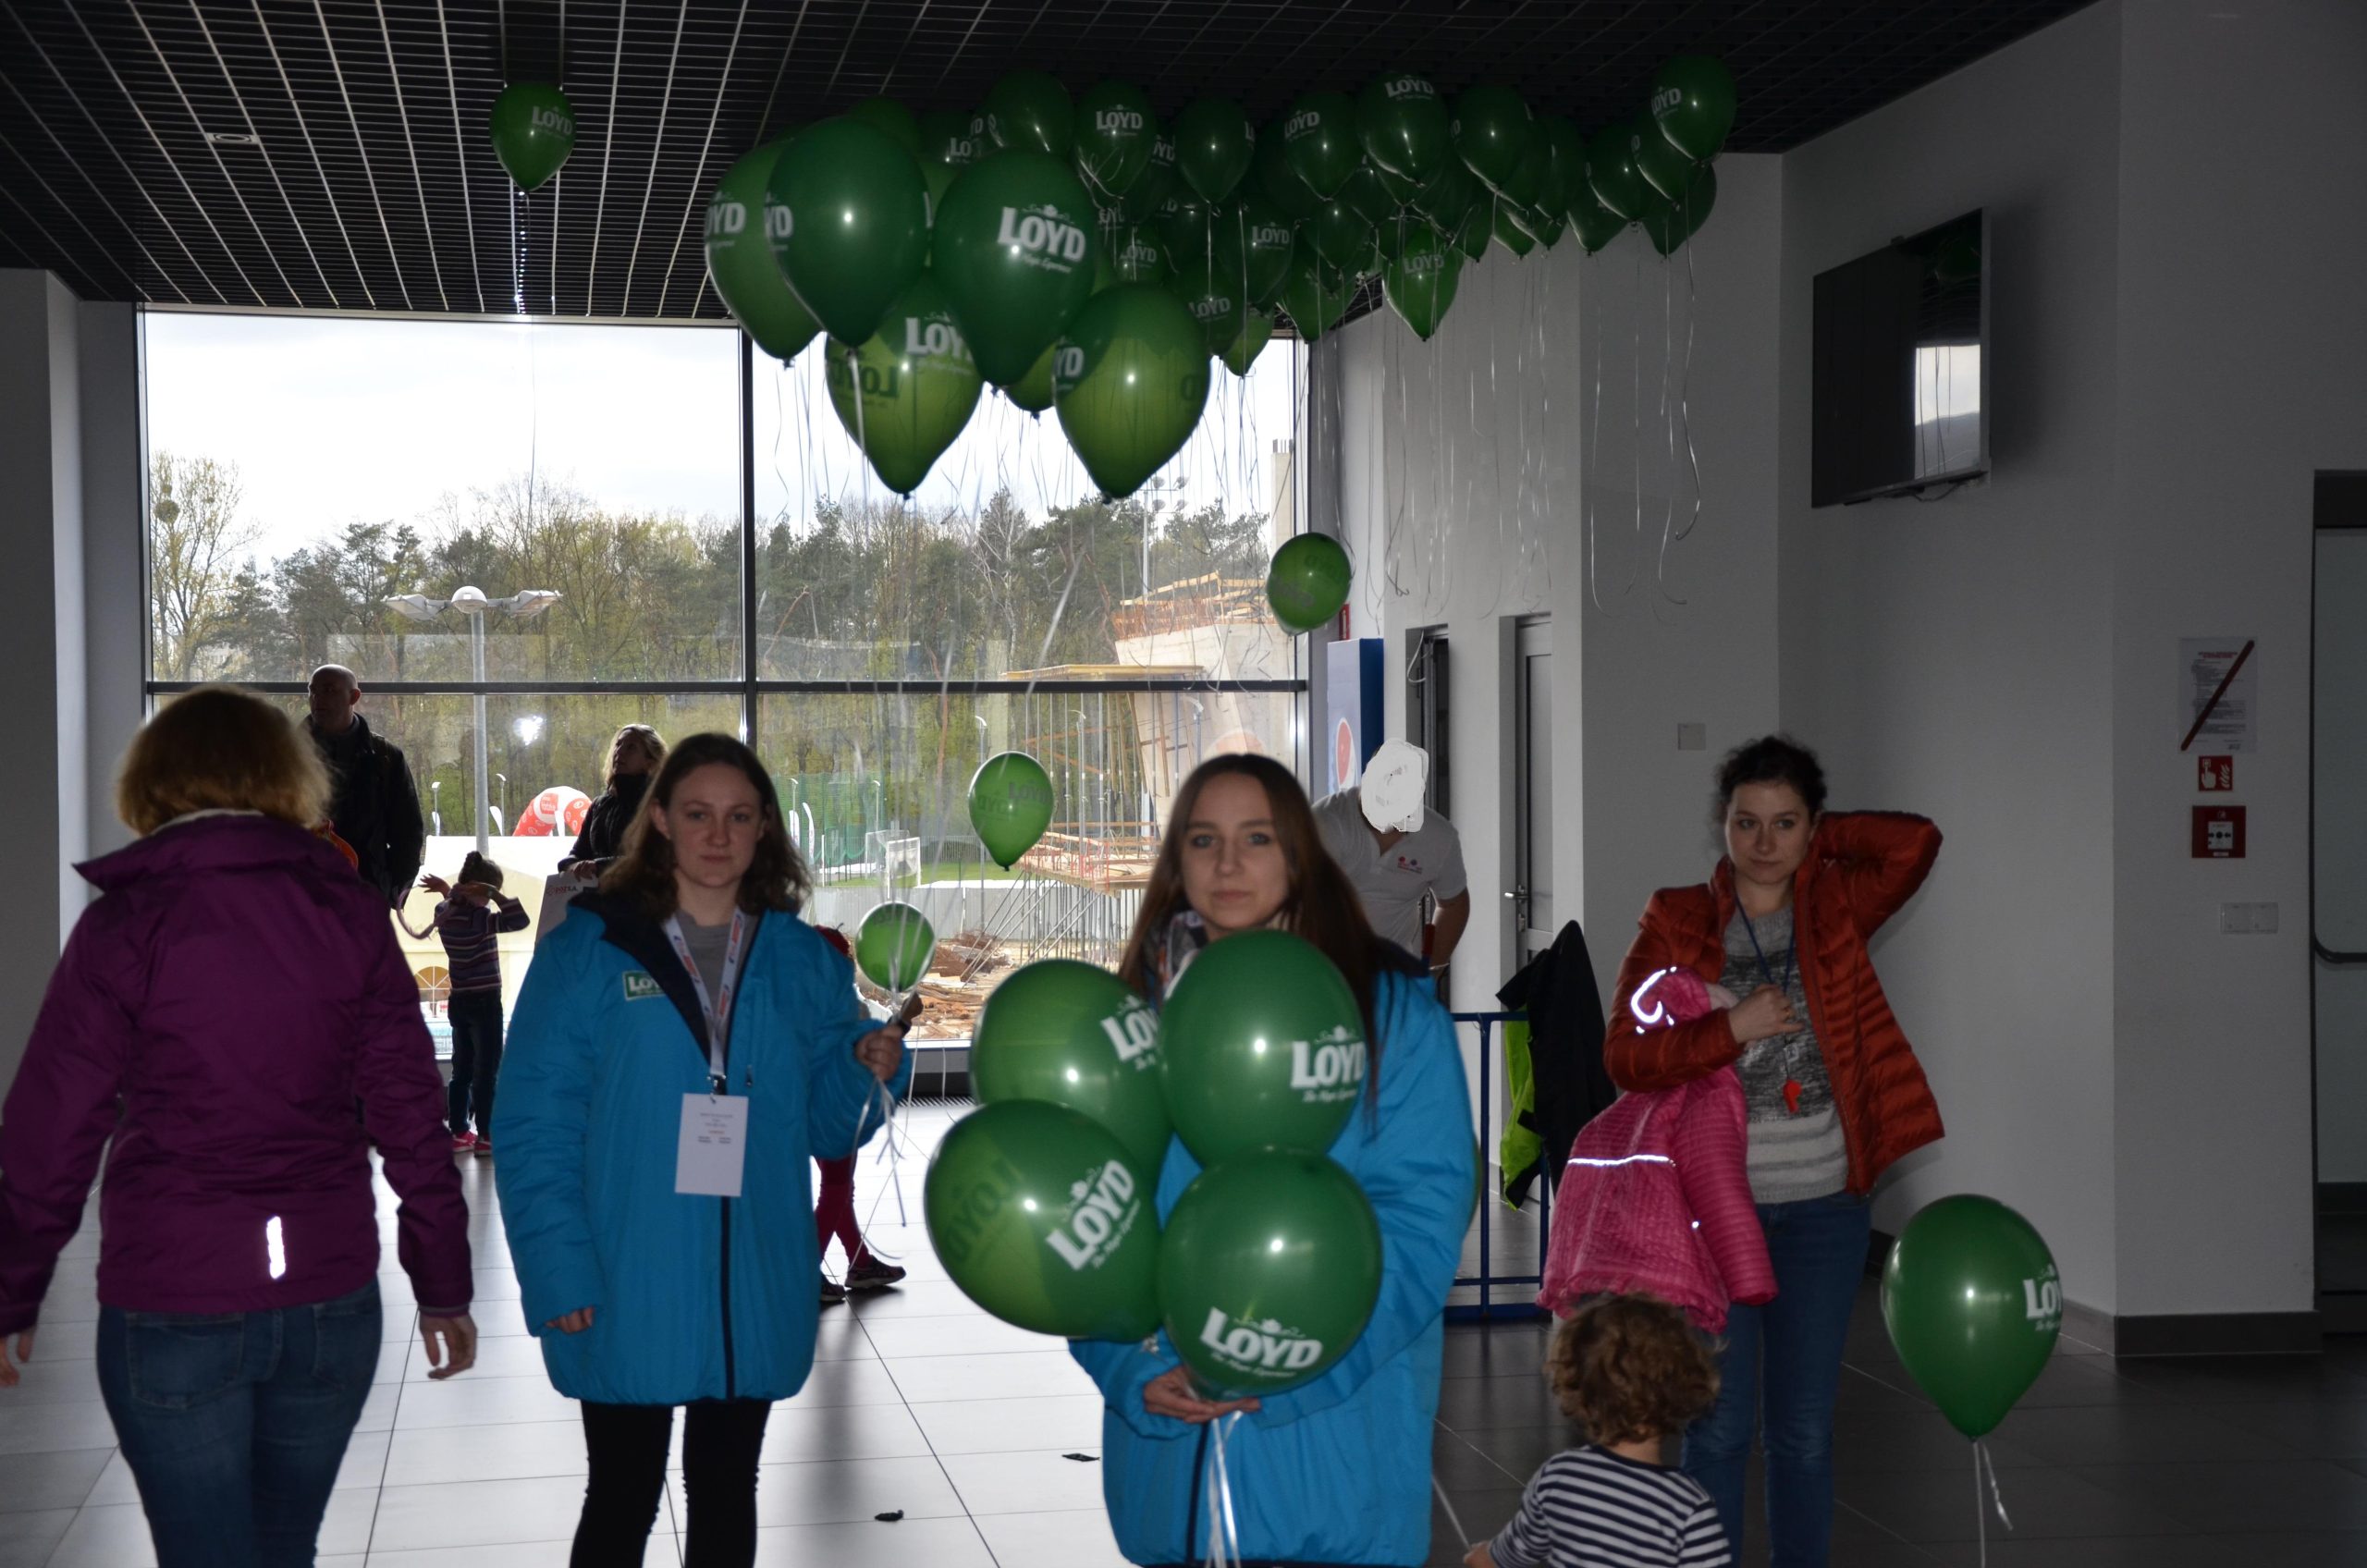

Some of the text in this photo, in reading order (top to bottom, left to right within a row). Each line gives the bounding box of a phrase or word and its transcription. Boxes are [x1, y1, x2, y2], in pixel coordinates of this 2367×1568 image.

[1384, 79, 1435, 98] LOYD
[532, 106, 572, 135] LOYD
[1096, 110, 1143, 130] LOYD
[1284, 112, 1320, 139] LOYD
[950, 137, 973, 157] LO
[998, 206, 1086, 263] LOYD
[1251, 226, 1291, 245] LOYD
[905, 317, 974, 364] LOY
[1046, 1159, 1135, 1270] LOYD
[2022, 1279, 2062, 1318] LO
[1200, 1306, 1324, 1369] LOYD
